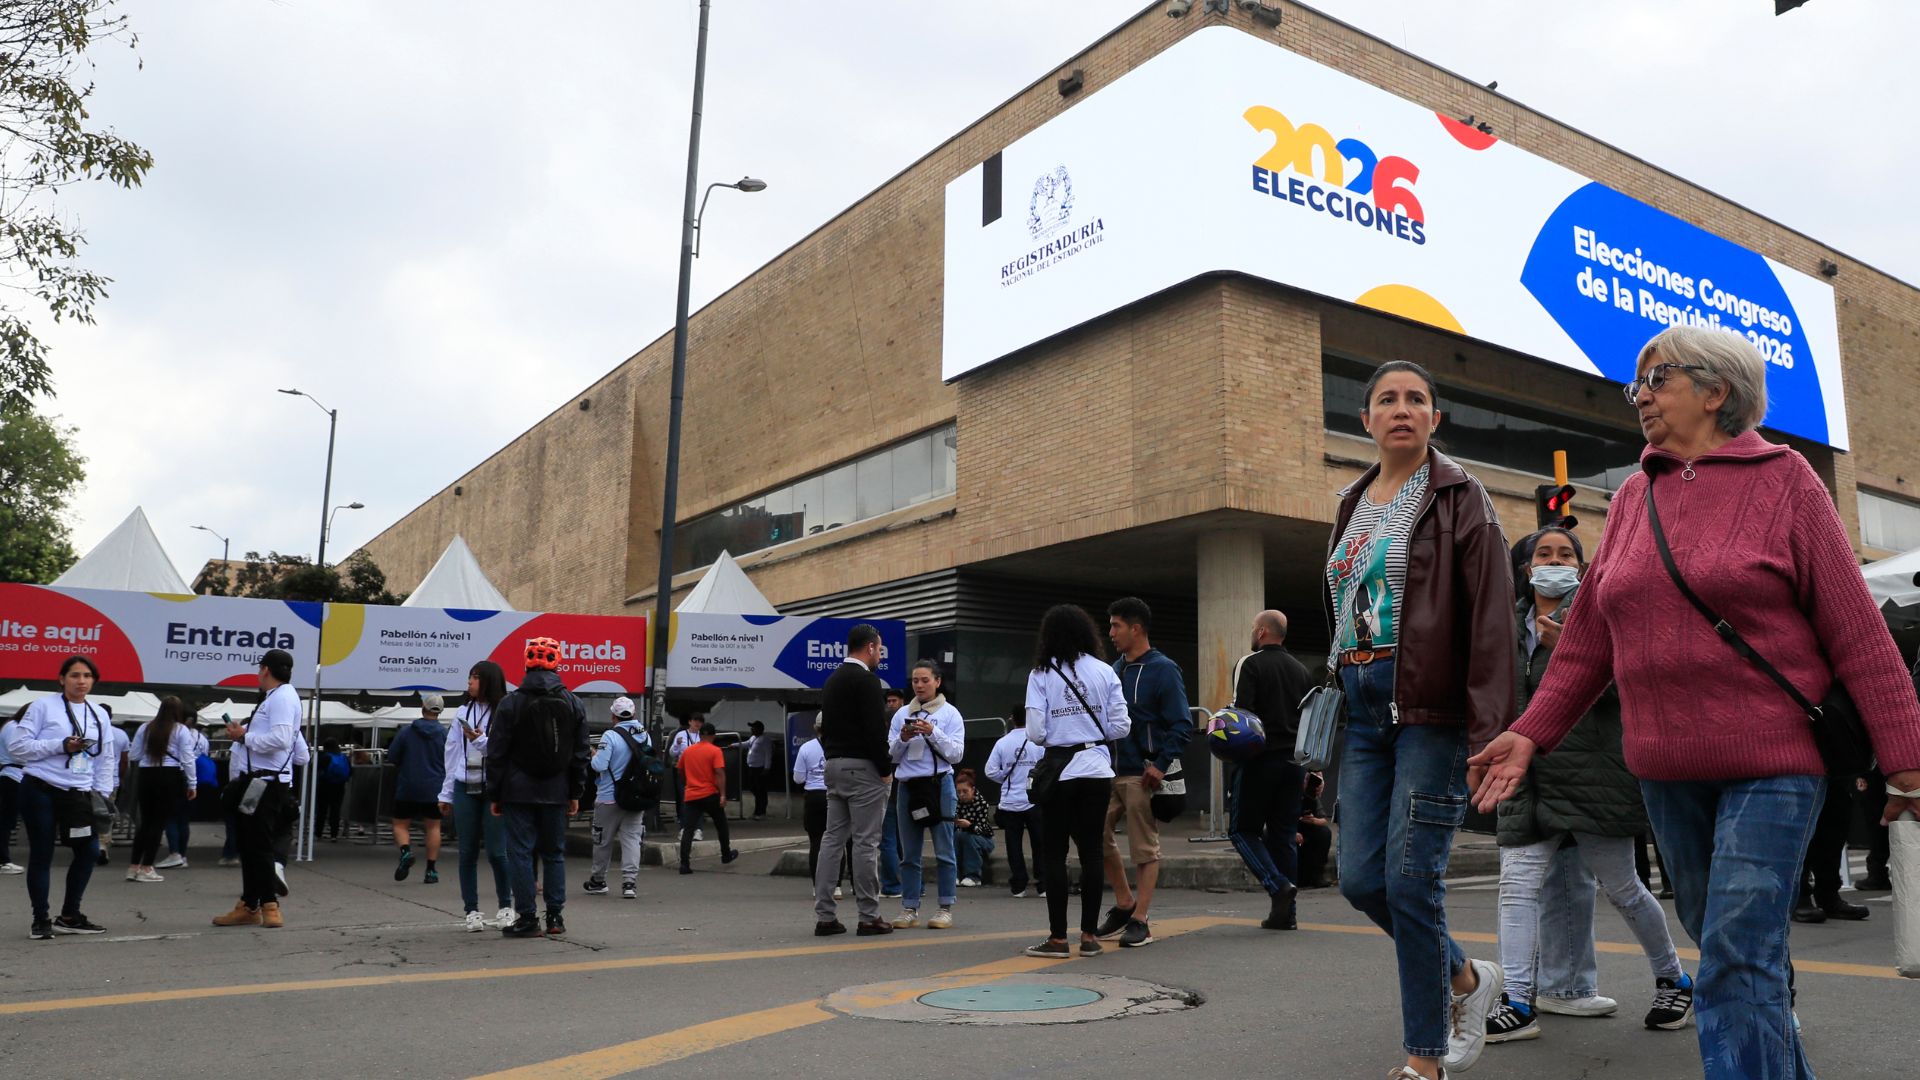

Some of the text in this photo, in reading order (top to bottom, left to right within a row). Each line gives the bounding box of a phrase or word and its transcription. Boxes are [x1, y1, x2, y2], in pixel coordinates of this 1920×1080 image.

[1242, 104, 1424, 224] 2026
[1252, 164, 1426, 245] ELECCIONES
[1001, 216, 1104, 279] REGISTRADURÍA
[1001, 234, 1104, 288] NACIONAL DEL ESTADO CIVIL
[1573, 225, 1792, 336] Elecciones Congreso
[1576, 266, 1608, 303] de
[1612, 276, 1635, 313] la
[0, 620, 103, 644] lte aquí
[166, 622, 295, 650] Entrada
[380, 629, 428, 639] Pabellón
[430, 631, 437, 640] 4
[440, 630, 464, 640] nivel
[691, 633, 728, 641] Pabellón
[738, 634, 758, 642] nivel
[23, 642, 40, 652] de
[43, 644, 98, 654] votación
[164, 648, 223, 662] Ingreso
[526, 638, 626, 660] trada
[379, 655, 437, 665] Gran Salón
[573, 662, 620, 674] mujeres
[691, 656, 737, 664] Gran Salón
